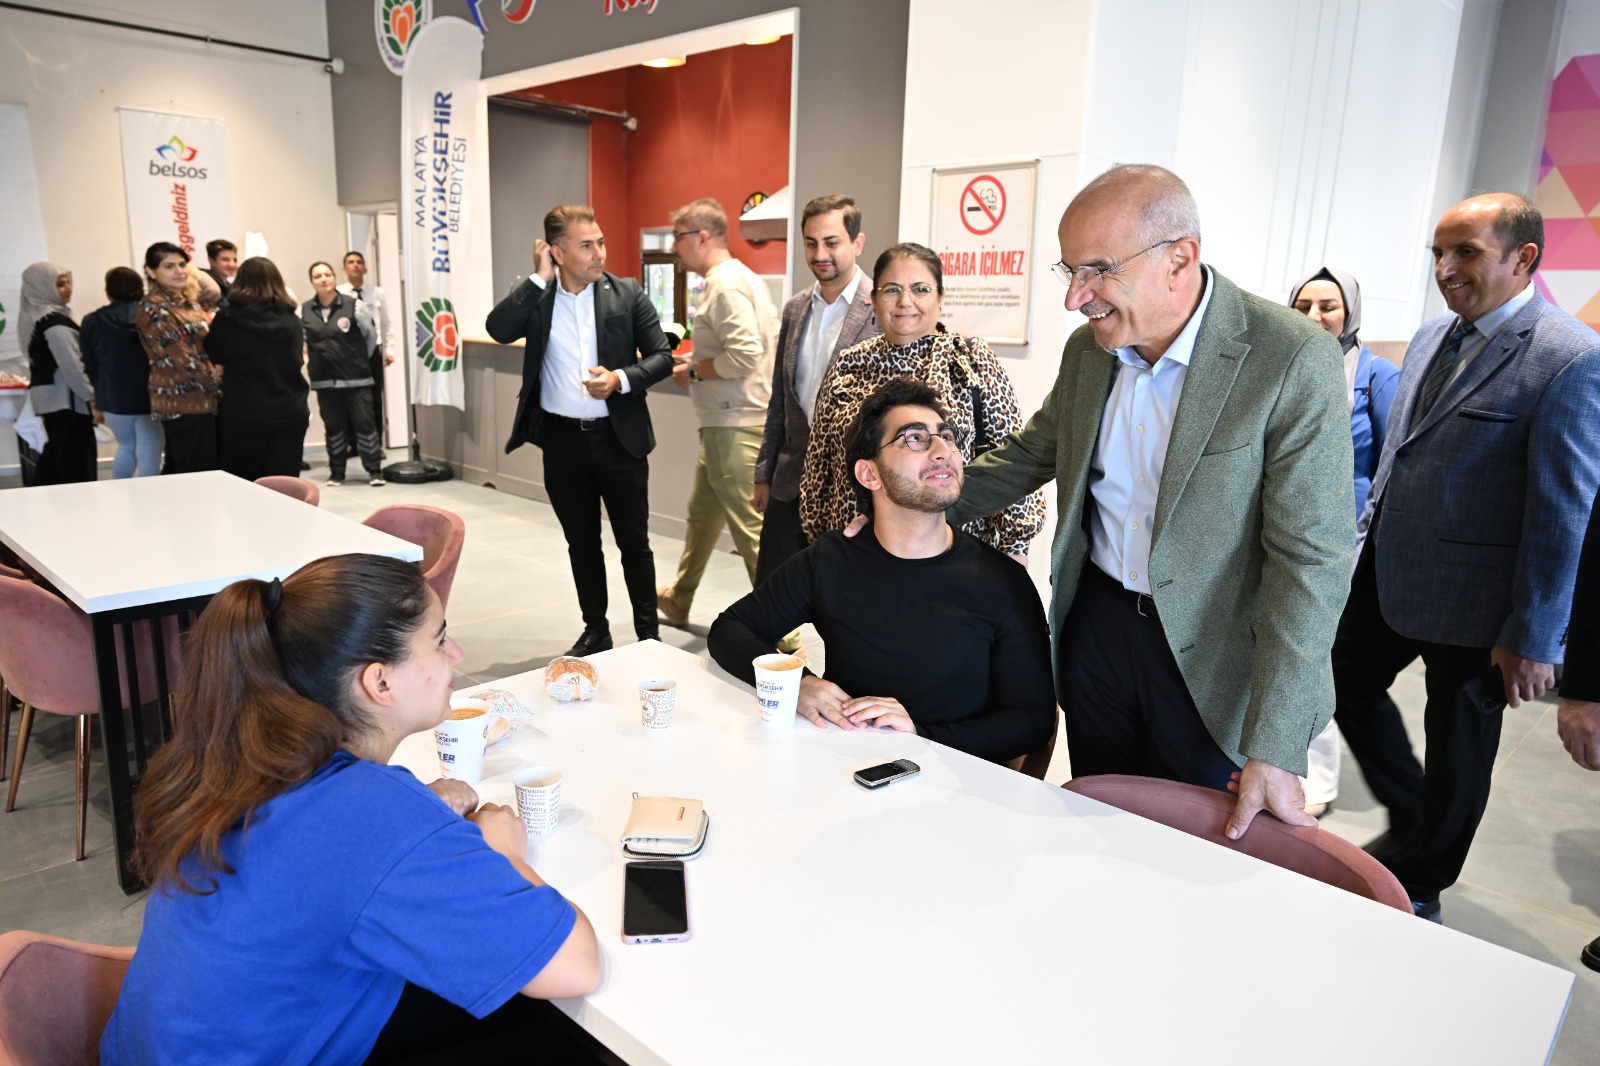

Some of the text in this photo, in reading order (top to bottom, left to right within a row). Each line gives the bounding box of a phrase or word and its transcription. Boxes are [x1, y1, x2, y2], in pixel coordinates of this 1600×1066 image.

[148, 160, 208, 180] belsos
[414, 135, 428, 228] MALATYA
[979, 244, 1025, 280] İÇİLMEZ
